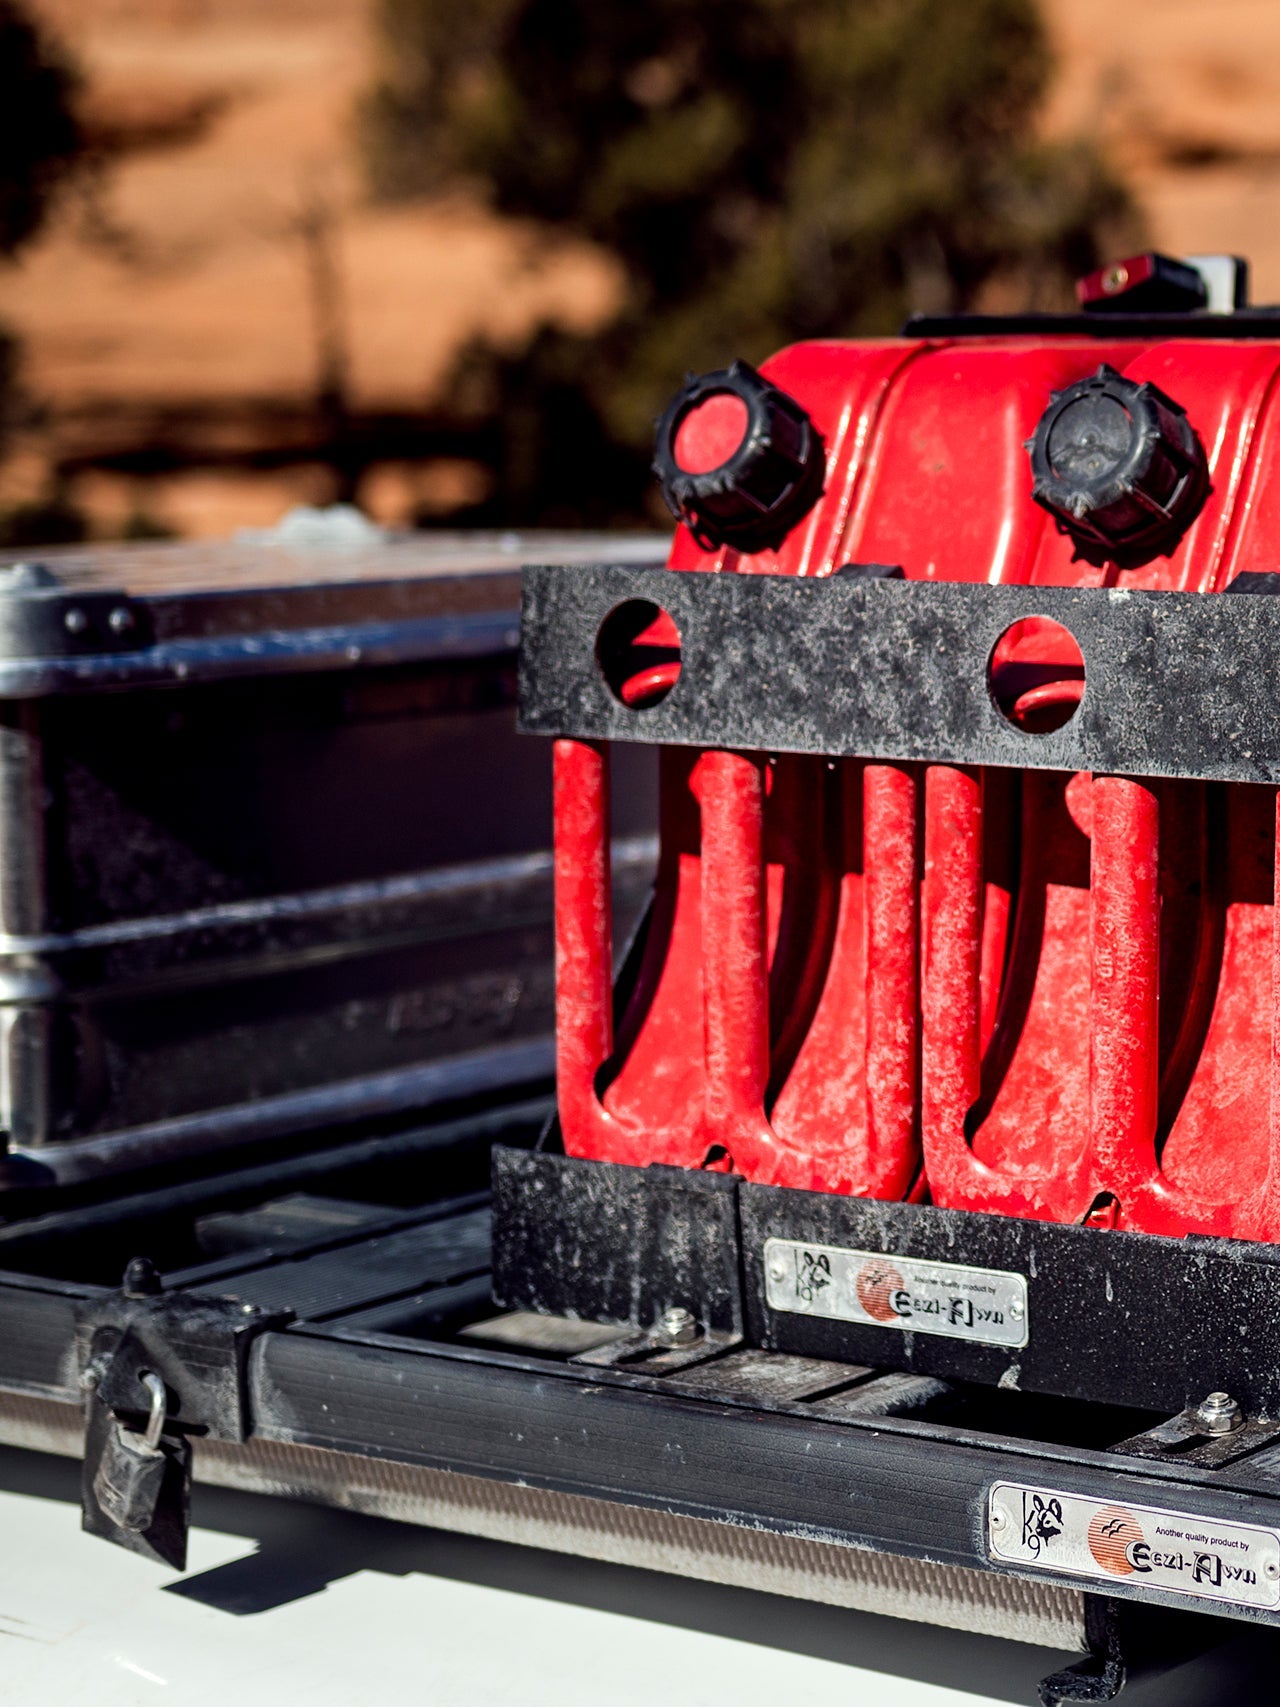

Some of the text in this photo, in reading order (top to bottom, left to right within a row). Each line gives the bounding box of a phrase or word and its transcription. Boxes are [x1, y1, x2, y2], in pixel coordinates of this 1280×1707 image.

[1155, 1526, 1250, 1552] Another quality product by
[1125, 1540, 1256, 1586] Eezi-Awn
